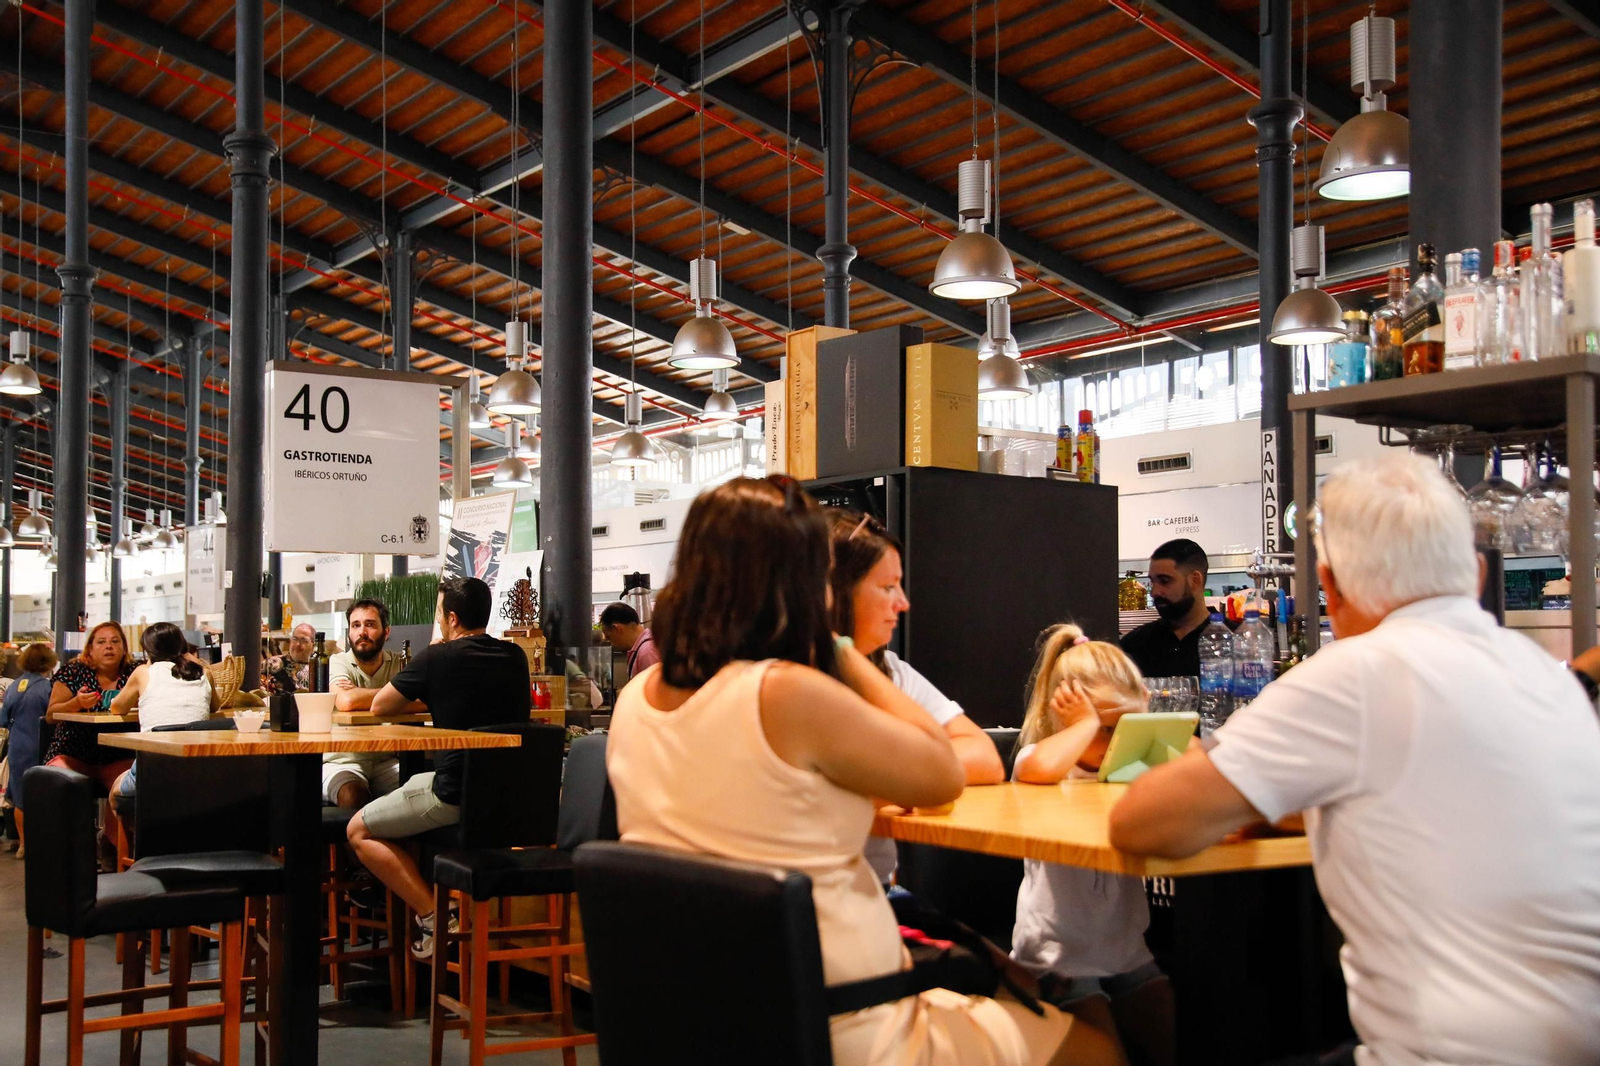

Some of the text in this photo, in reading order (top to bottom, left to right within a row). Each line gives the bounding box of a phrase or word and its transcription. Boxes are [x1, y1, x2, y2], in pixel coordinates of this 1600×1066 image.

[284, 383, 350, 434] 40
[913, 399, 921, 465] CENTVM
[283, 449, 373, 465] GASTROTIENDA
[294, 469, 368, 482] IBÉRICOS ORTUÑO
[1175, 525, 1200, 534] EXPRESS
[381, 534, 404, 543] C-6.1
